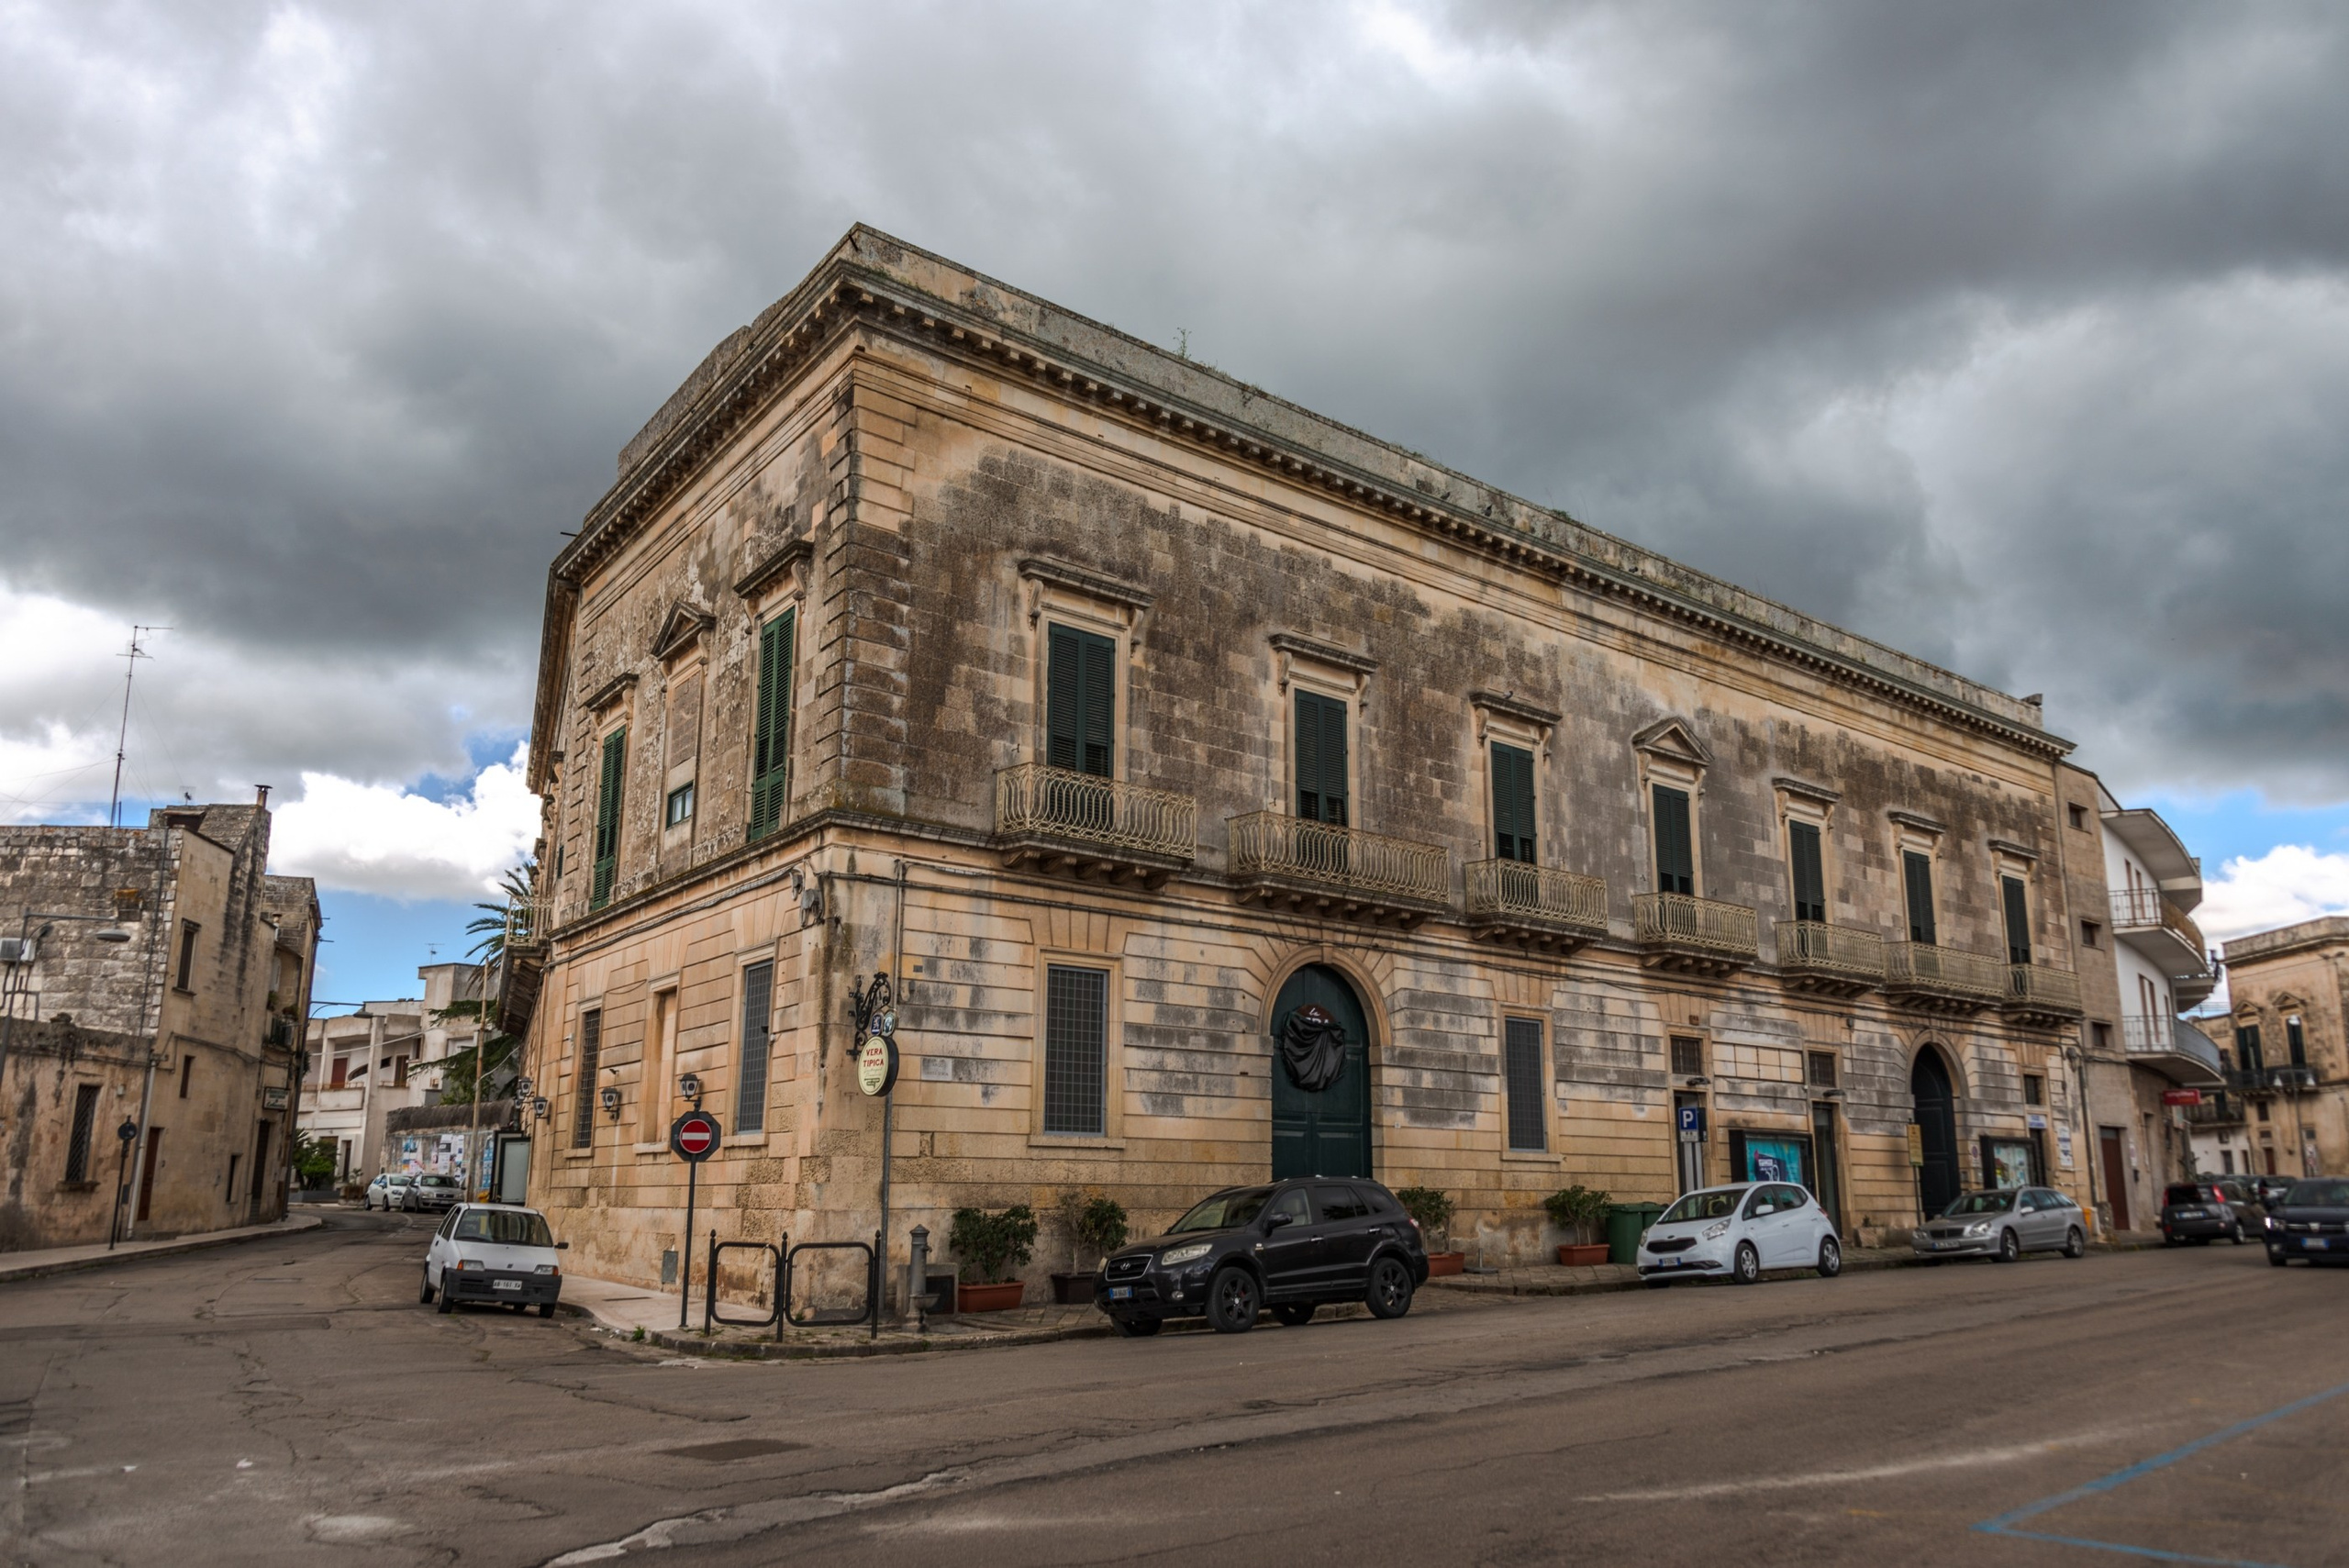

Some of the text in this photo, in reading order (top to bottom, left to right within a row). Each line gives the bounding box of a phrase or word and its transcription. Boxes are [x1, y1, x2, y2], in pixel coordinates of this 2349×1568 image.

[866, 1048, 883, 1056] VERA
[863, 1059, 885, 1068] TIPICA
[1682, 1110, 1694, 1129] P
